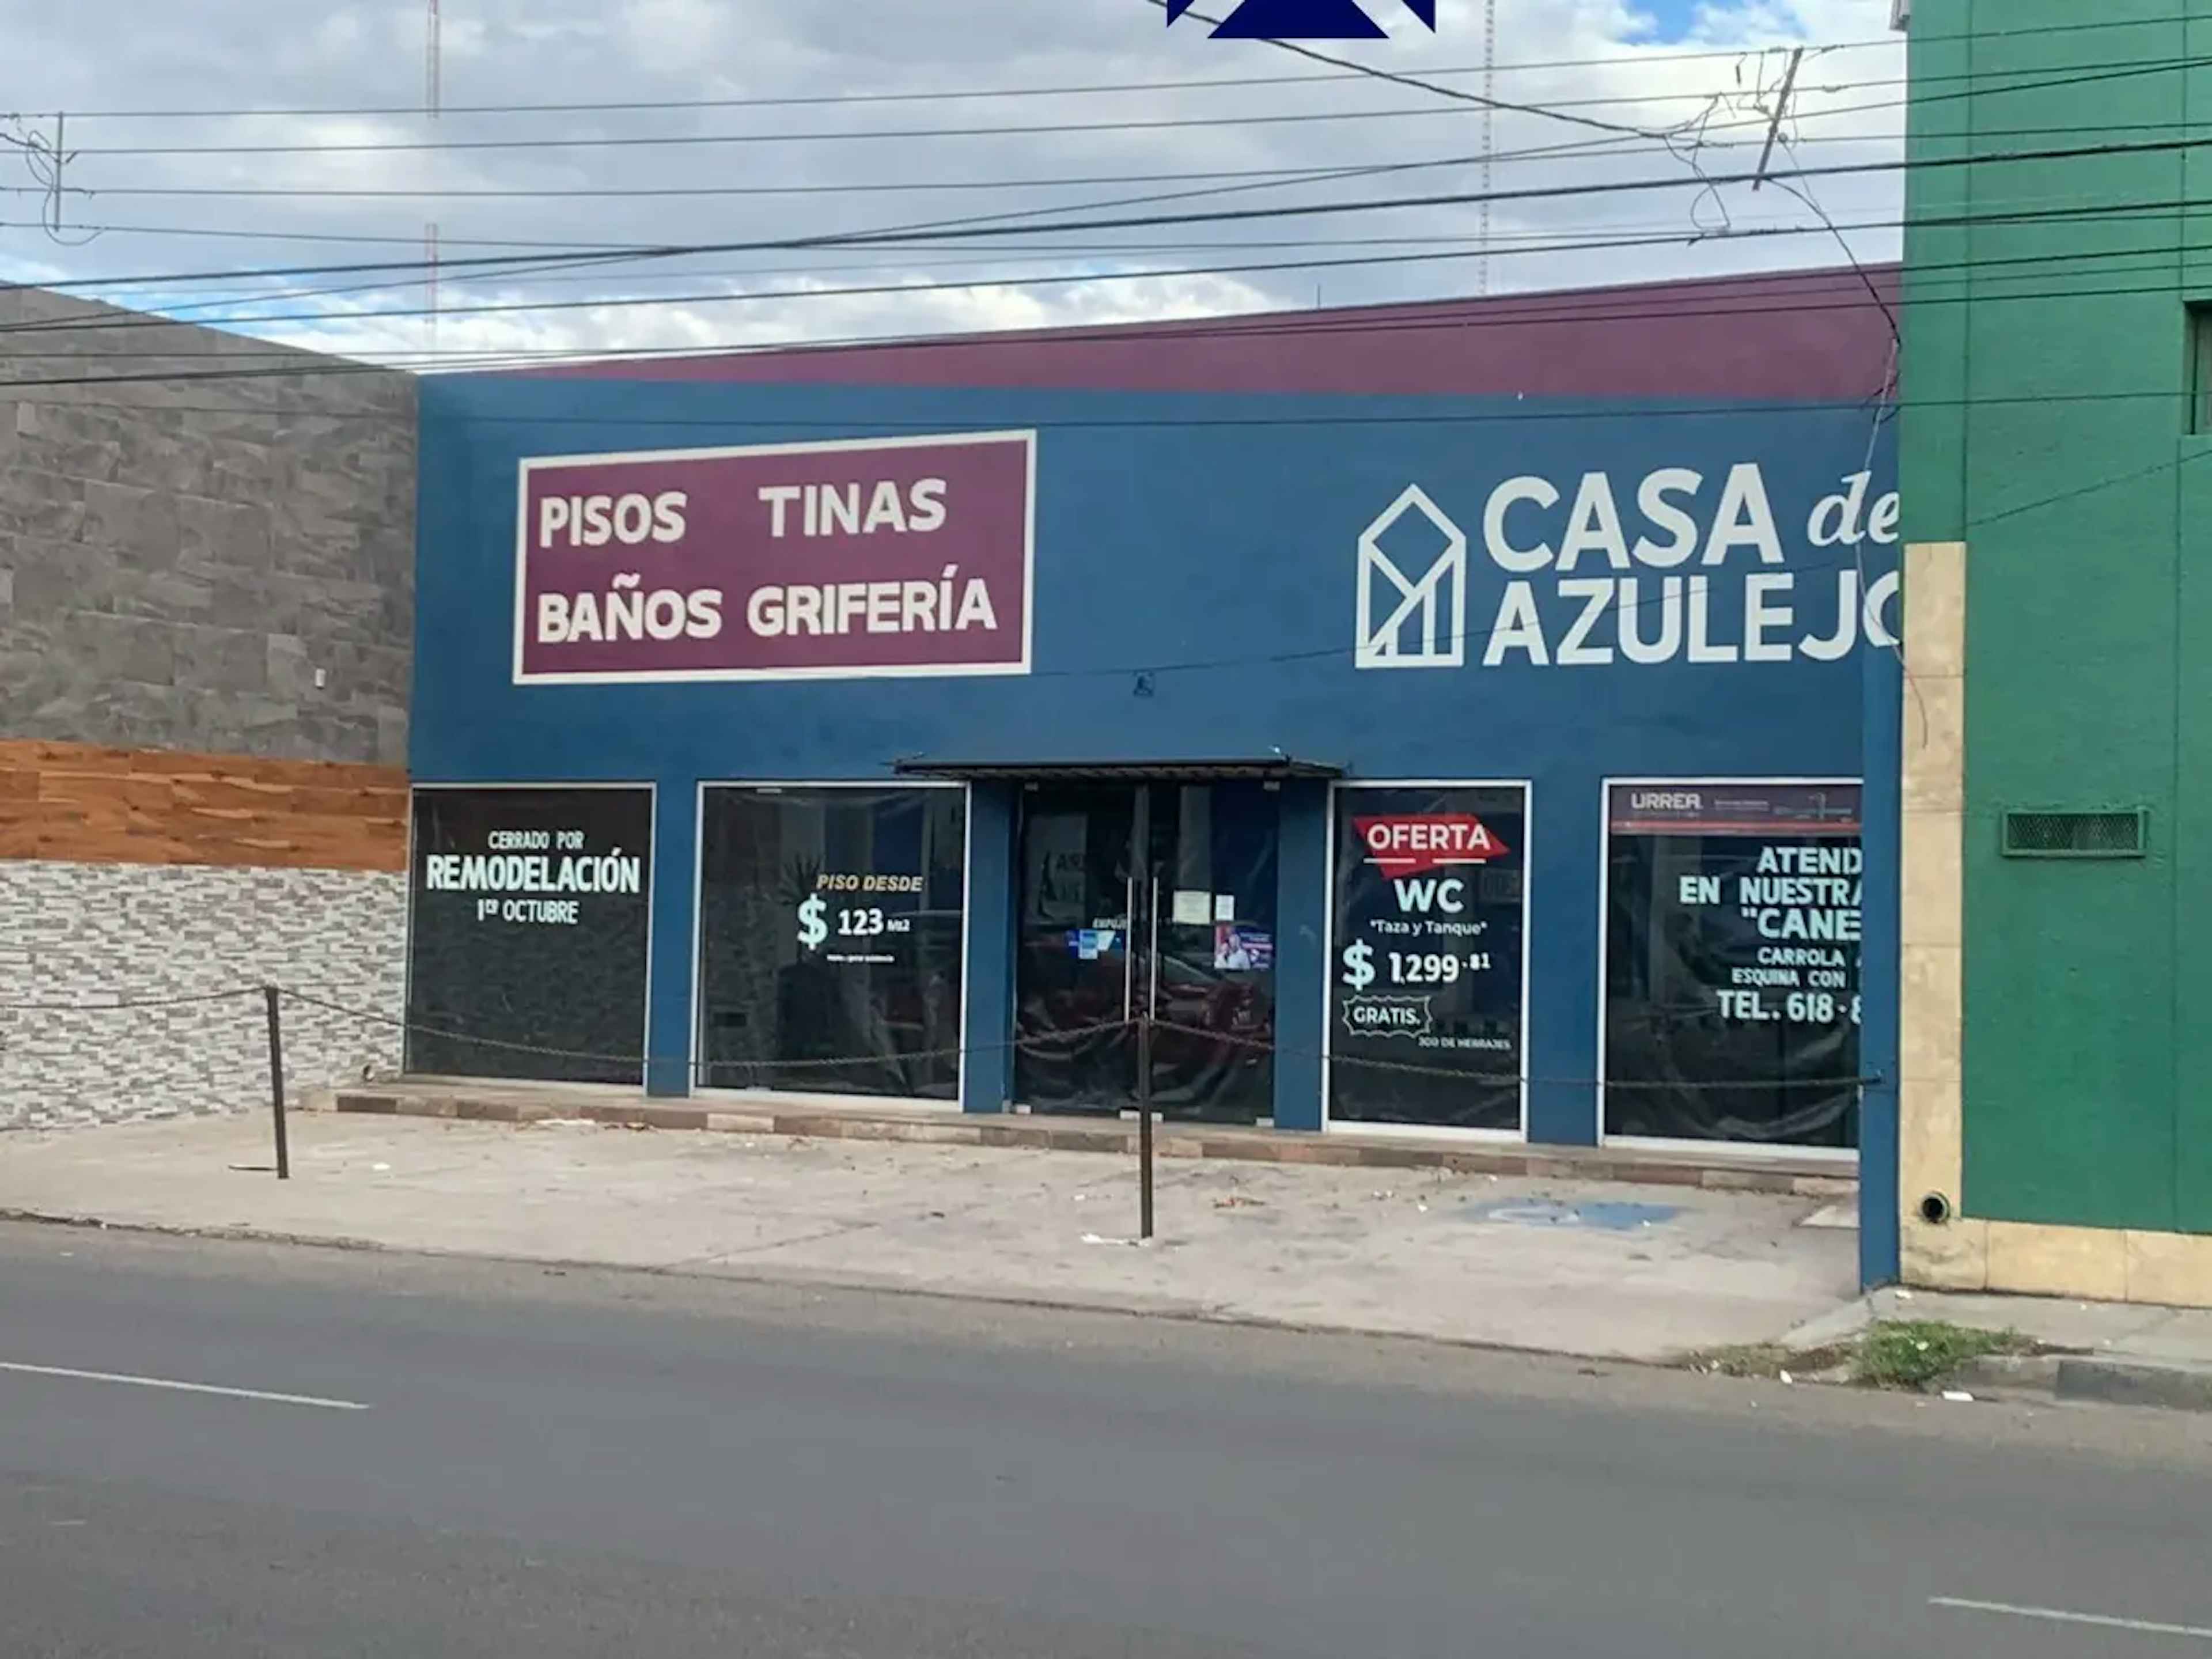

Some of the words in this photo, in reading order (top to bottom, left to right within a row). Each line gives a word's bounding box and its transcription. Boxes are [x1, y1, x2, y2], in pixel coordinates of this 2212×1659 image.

[540, 491, 687, 548] PISOS
[759, 478, 946, 537] TINAS
[1483, 463, 1785, 572] CASA
[538, 573, 723, 643] BAÑOS
[747, 564, 997, 637] GRIFERÍA
[1631, 793, 1703, 809] URREA
[488, 831, 550, 850] CERRADO
[556, 830, 584, 850] POR
[1367, 824, 1490, 850] OFERTA
[426, 847, 640, 893] REMODELACIÓN
[816, 874, 859, 891] PISO
[862, 875, 923, 892] DESDE
[1393, 878, 1464, 913] WC
[1680, 876, 1720, 904] EN
[502, 899, 579, 925] OCTUBRE
[797, 893, 828, 950] $
[838, 908, 884, 935] 123
[1412, 923, 1422, 937] y
[1342, 938, 1376, 991] $
[1758, 946, 1846, 967] CARROLA
[1732, 968, 1800, 987] ESQUINA
[1808, 970, 1846, 988] CON
[1353, 1006, 1421, 1025] GRATIS.
[1715, 989, 1781, 1020] TEL.
